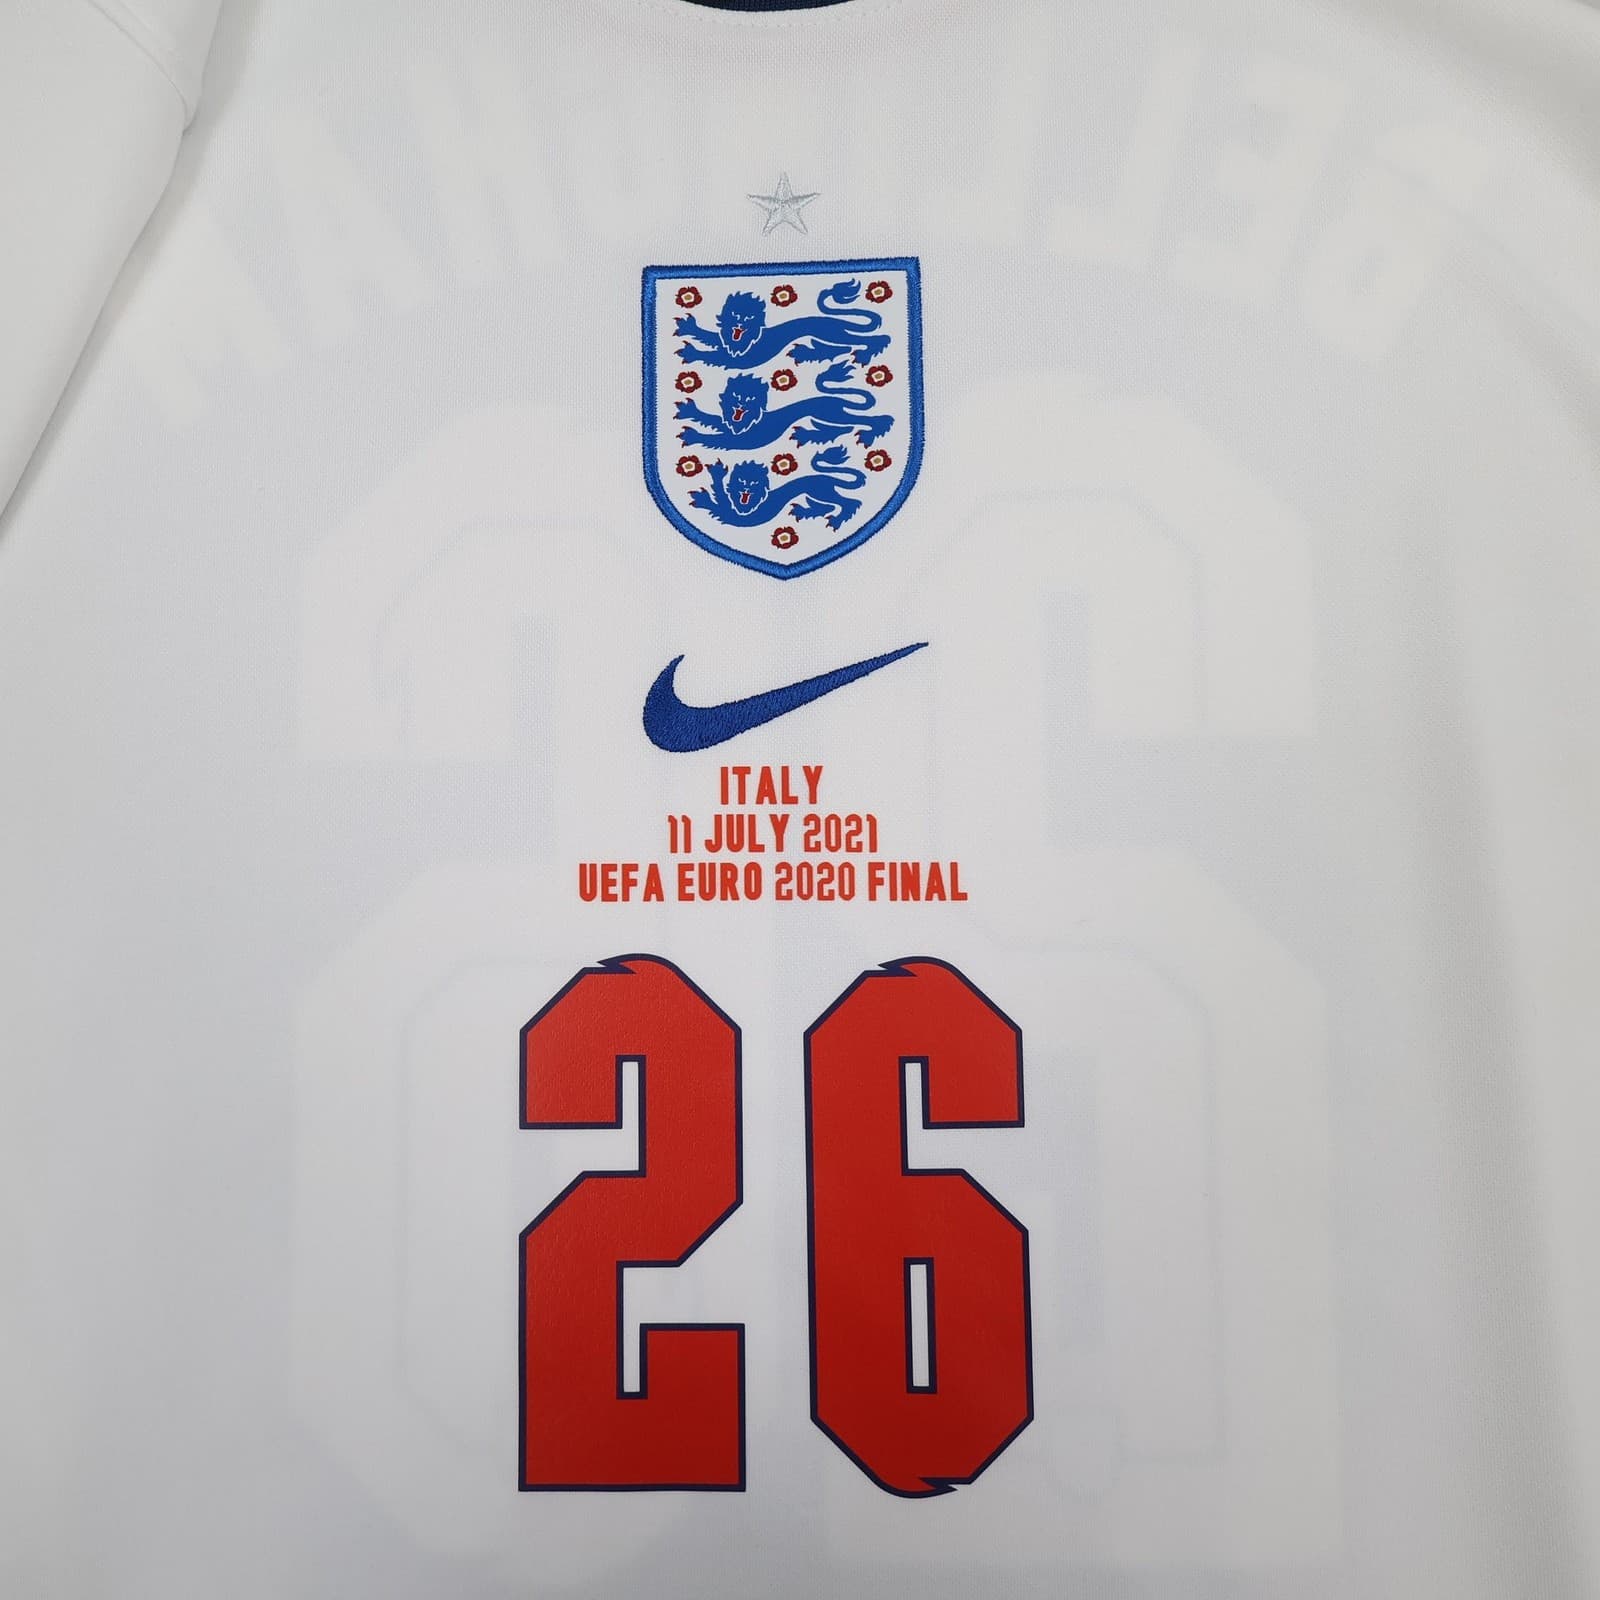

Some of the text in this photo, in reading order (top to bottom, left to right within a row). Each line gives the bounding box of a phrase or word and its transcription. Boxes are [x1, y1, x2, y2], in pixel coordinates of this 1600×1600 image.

[719, 765, 823, 805] ITALY
[668, 813, 878, 854] 11 JULY 2021
[578, 861, 968, 902] UEFA EURO 2020 FINAL
[519, 954, 1034, 1498] 26
